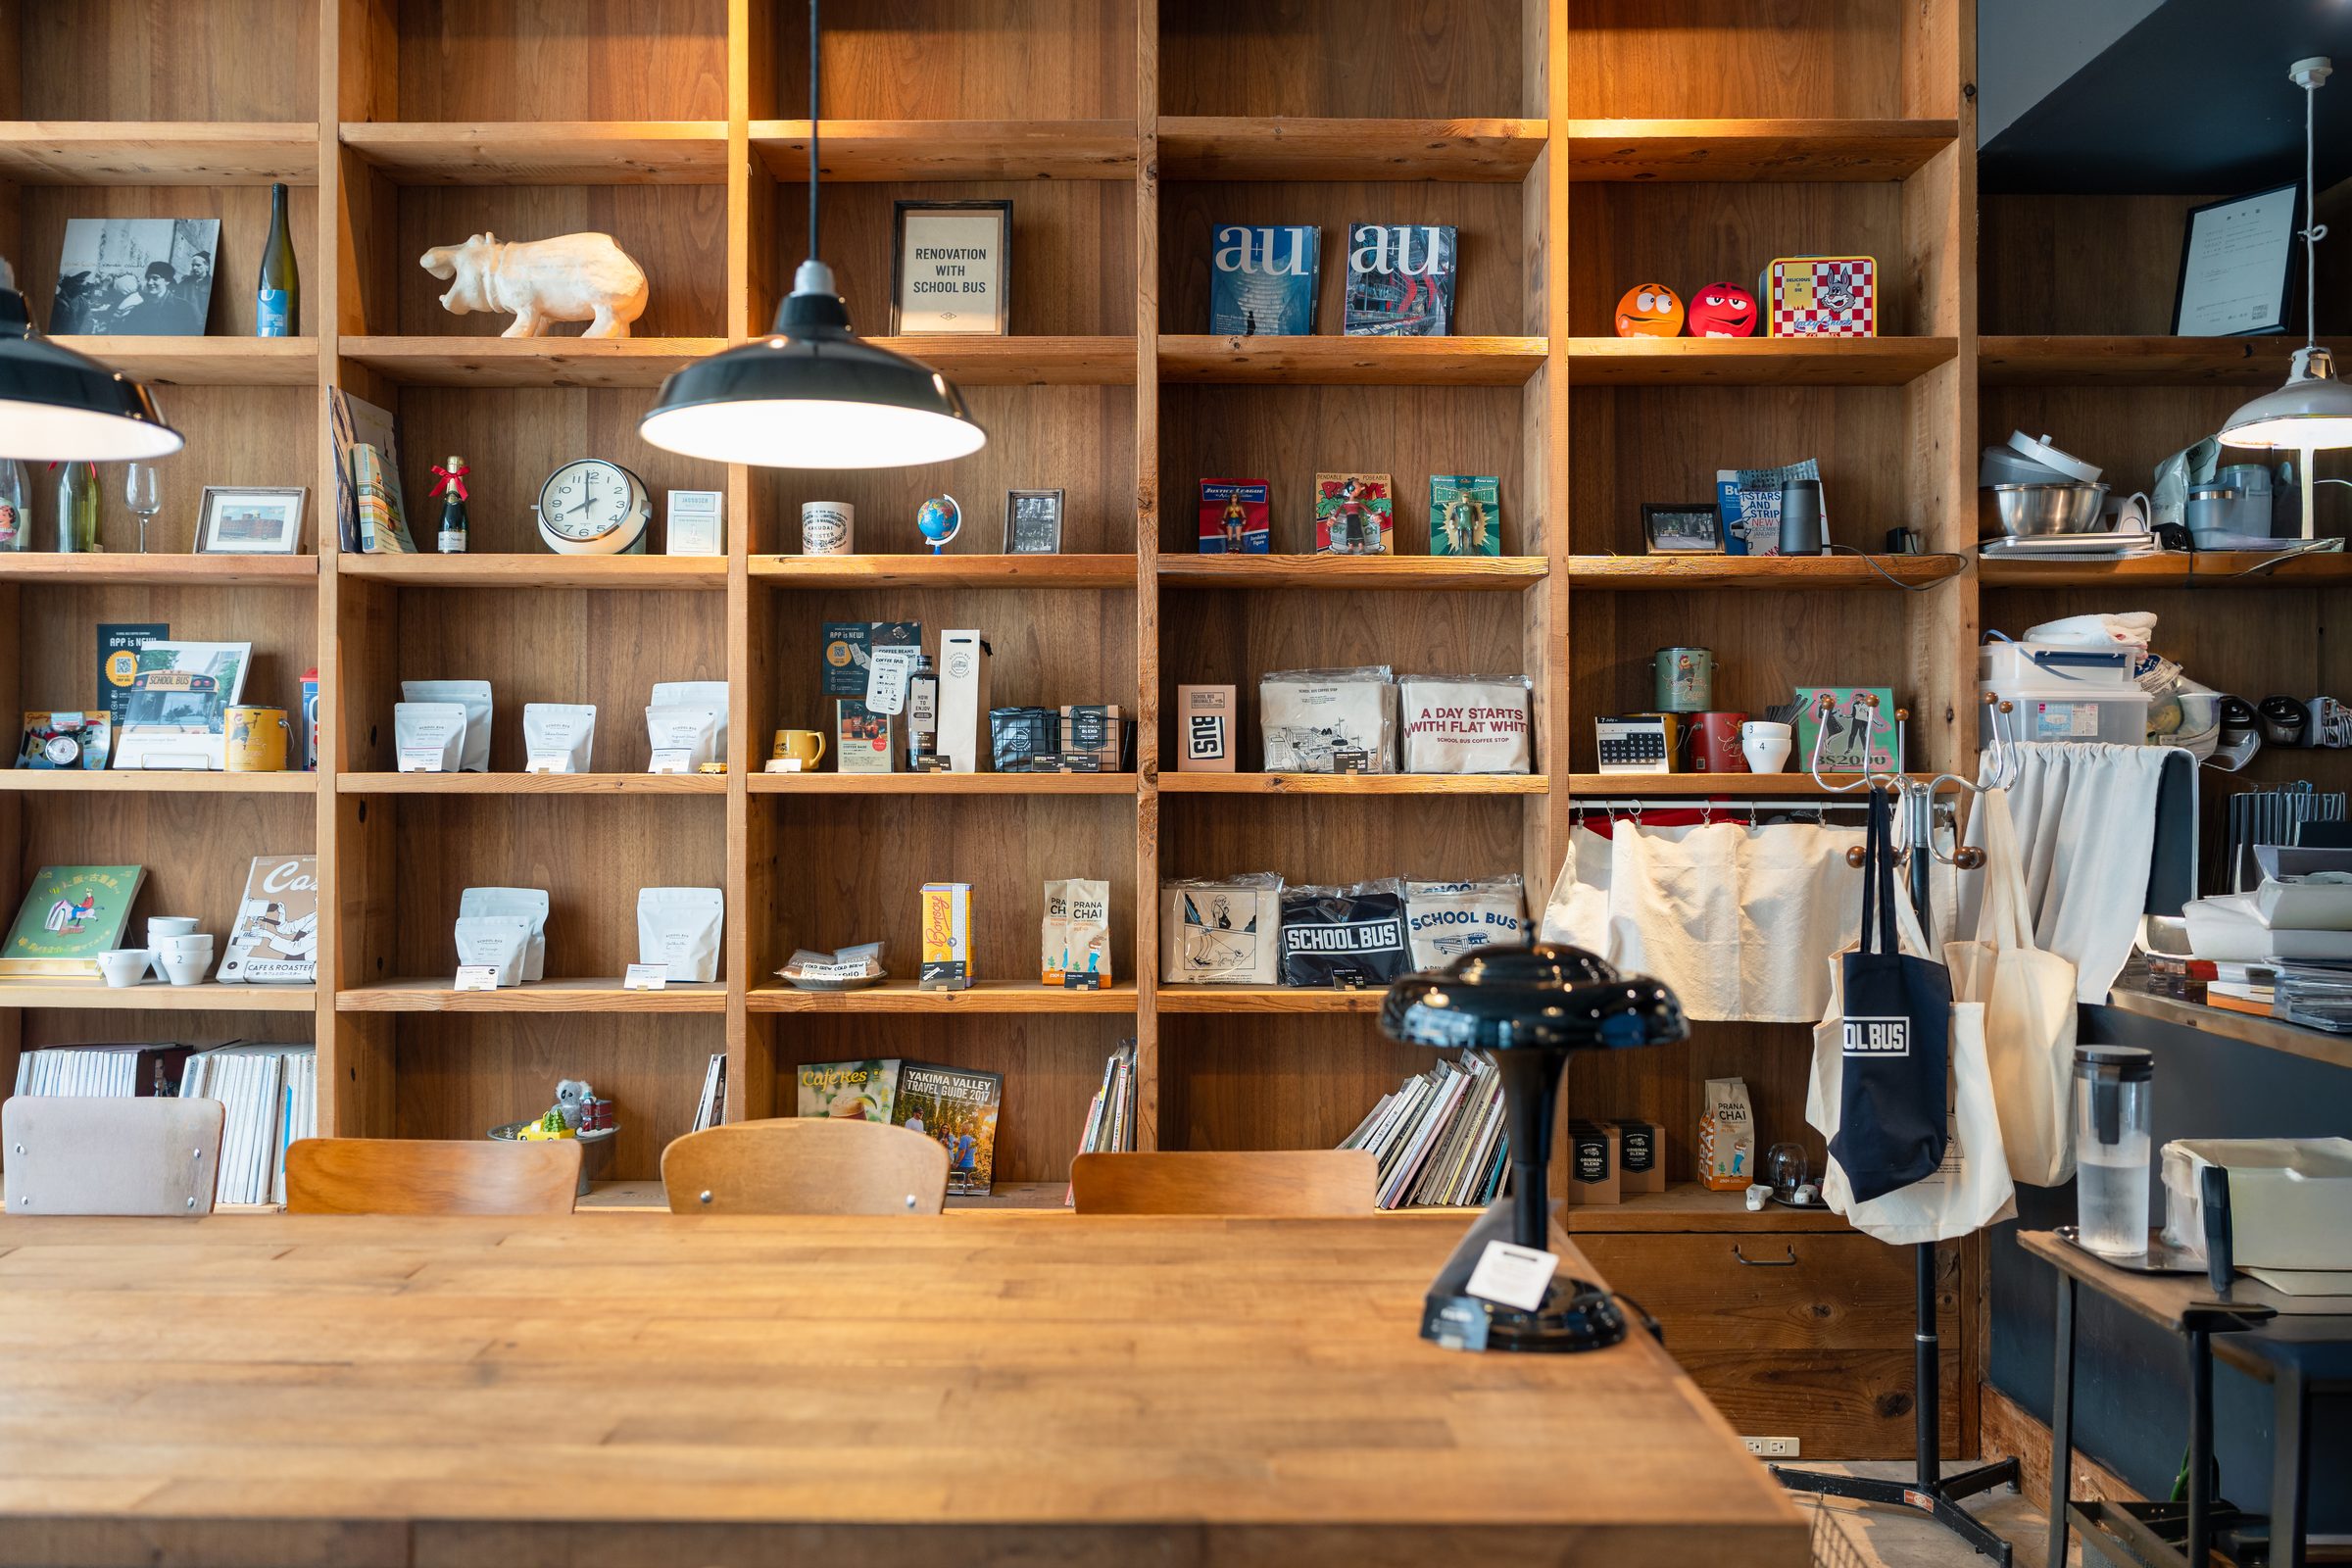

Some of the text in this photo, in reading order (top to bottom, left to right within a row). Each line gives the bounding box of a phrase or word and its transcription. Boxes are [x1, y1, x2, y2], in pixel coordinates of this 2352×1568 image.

[915, 248, 987, 260] RENOVATION
[936, 265, 965, 276] WITH
[913, 281, 986, 293] SCHOOL BUS
[572, 475, 581, 484] 11
[1749, 492, 1781, 501] STARS
[1749, 501, 1771, 510] AND
[1750, 510, 1781, 518] STRIP
[110, 638, 126, 647] APP
[127, 638, 135, 647] is
[149, 675, 190, 685] SCHOOL BUS
[1421, 708, 1524, 720] A DAY STARTS
[1411, 720, 1446, 733] WITH
[1450, 721, 1486, 733] FLAT
[1490, 721, 1528, 733] WHIT
[1748, 725, 1754, 734] 3
[1192, 716, 1218, 753] BUS
[1759, 742, 1765, 751] 4
[1051, 905, 1066, 914] CH
[1073, 908, 1102, 918] CHAI
[925, 896, 950, 947] Bonsoy
[1410, 911, 1518, 930] SCHOOL BUS
[1288, 924, 1397, 950] SCHOOL BUS
[1869, 1023, 1904, 1050] BUS
[908, 1070, 992, 1091] YAKIMA VALLEY
[906, 1079, 990, 1102] TRAVEL GUIDE 2017
[1719, 1110, 1746, 1120] CHAI
